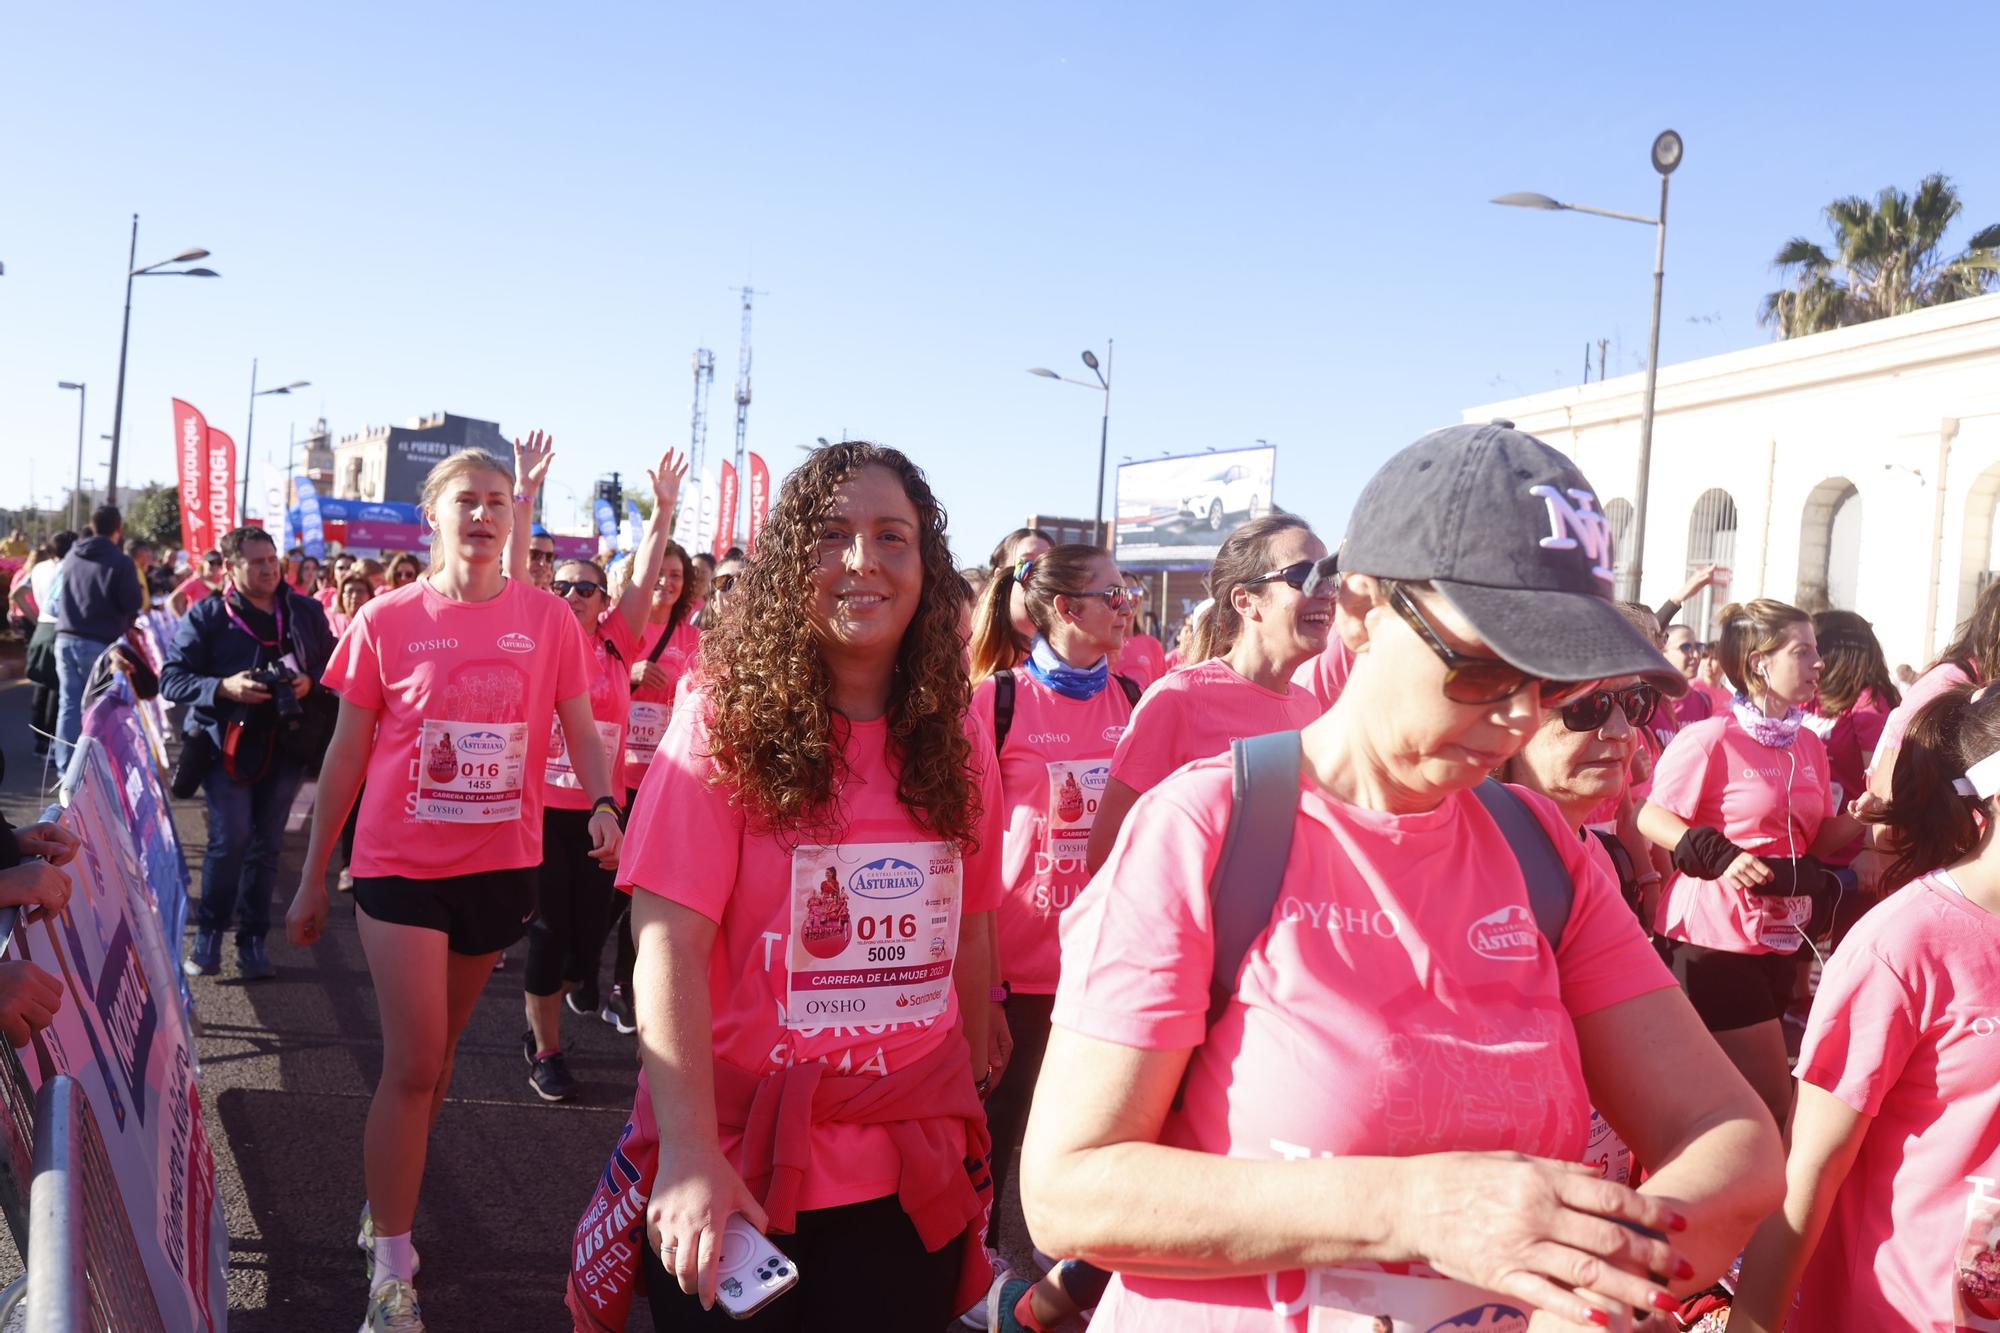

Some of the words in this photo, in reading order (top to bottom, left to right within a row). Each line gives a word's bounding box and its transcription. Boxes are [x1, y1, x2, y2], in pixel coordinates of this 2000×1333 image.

[408, 638, 459, 653] OYSHO
[632, 725, 655, 736] 016
[460, 740, 503, 751] ASTURIANA
[1028, 733, 1070, 744] OYSHO
[461, 763, 499, 776] 016
[468, 780, 492, 789] 1455
[432, 791, 464, 800] CARRERA
[428, 804, 464, 816] OYSHO
[928, 864, 955, 876] SUMA
[855, 874, 920, 890] ASTURIANA
[1282, 897, 1401, 939] OYSHO
[857, 914, 917, 940] 016
[868, 946, 906, 961] 5009
[812, 976, 864, 986] CARRERA
[866, 973, 881, 983] DE
[883, 972, 897, 982] LA
[899, 970, 928, 981] MUJER
[929, 966, 944, 977] 2023
[909, 989, 943, 1007] Santander
[806, 999, 866, 1015] OYSHO
[577, 1194, 609, 1239] FAMOUS
[575, 1185, 649, 1272] AUSTRIA
